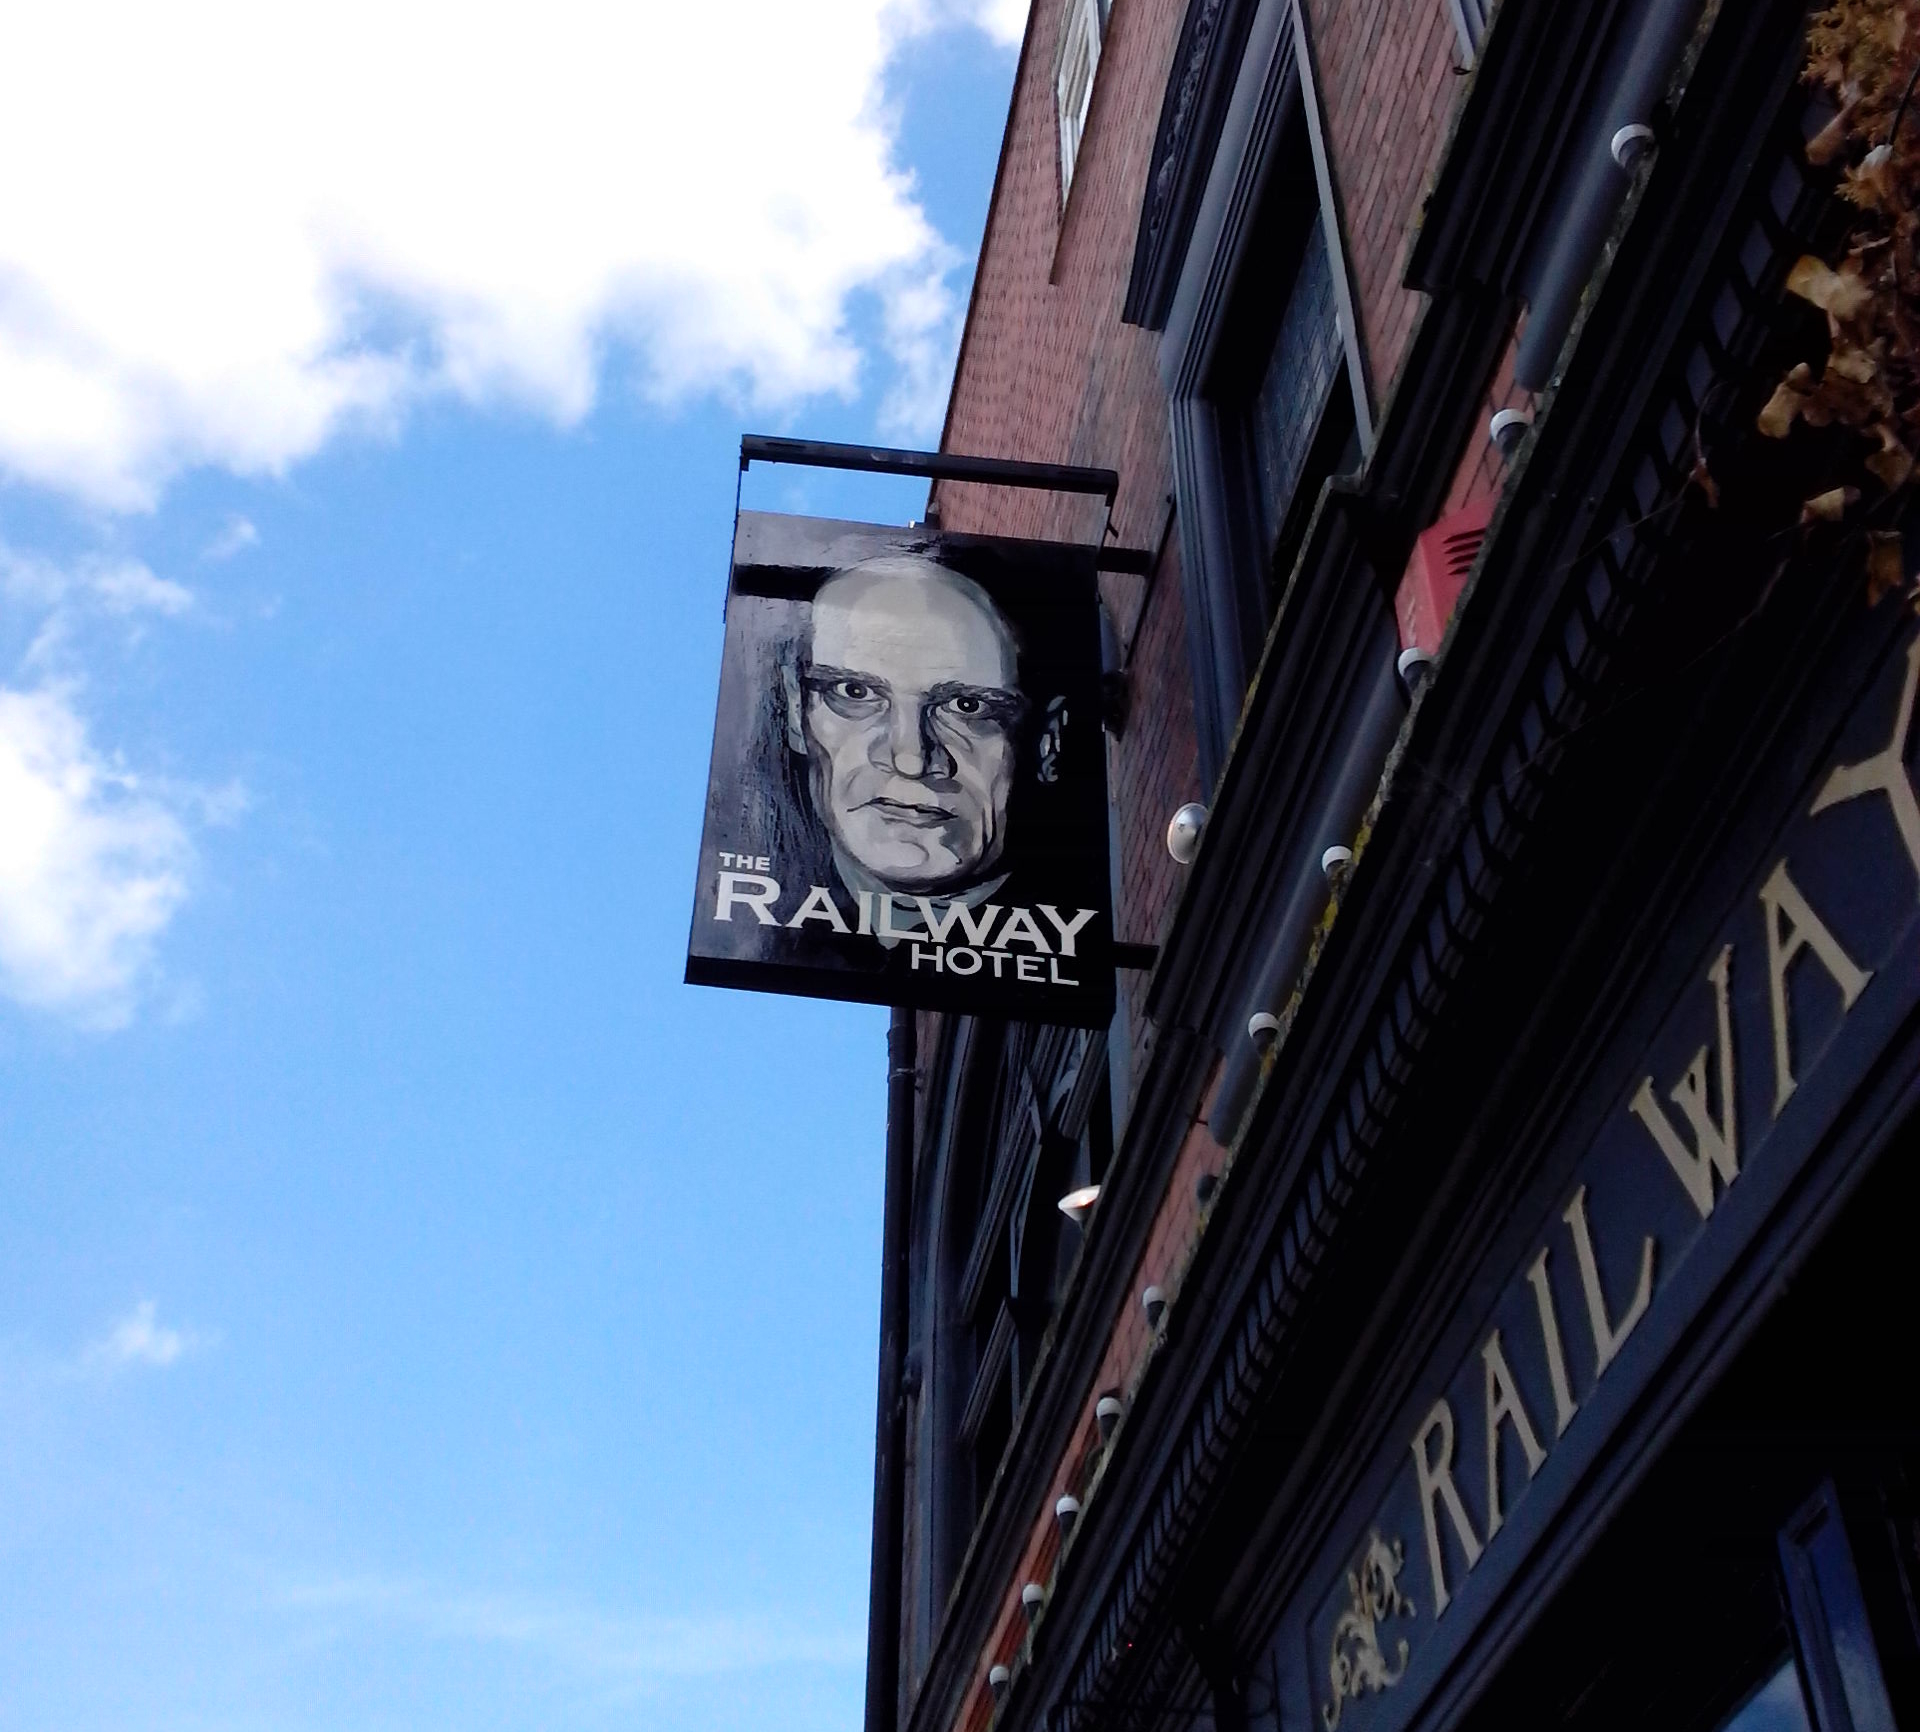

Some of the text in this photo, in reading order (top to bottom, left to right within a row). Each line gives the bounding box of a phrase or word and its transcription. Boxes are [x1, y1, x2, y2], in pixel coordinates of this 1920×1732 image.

[719, 852, 771, 871] THE
[713, 871, 1099, 956] RAILWAY
[910, 944, 1080, 986] HOTEL
